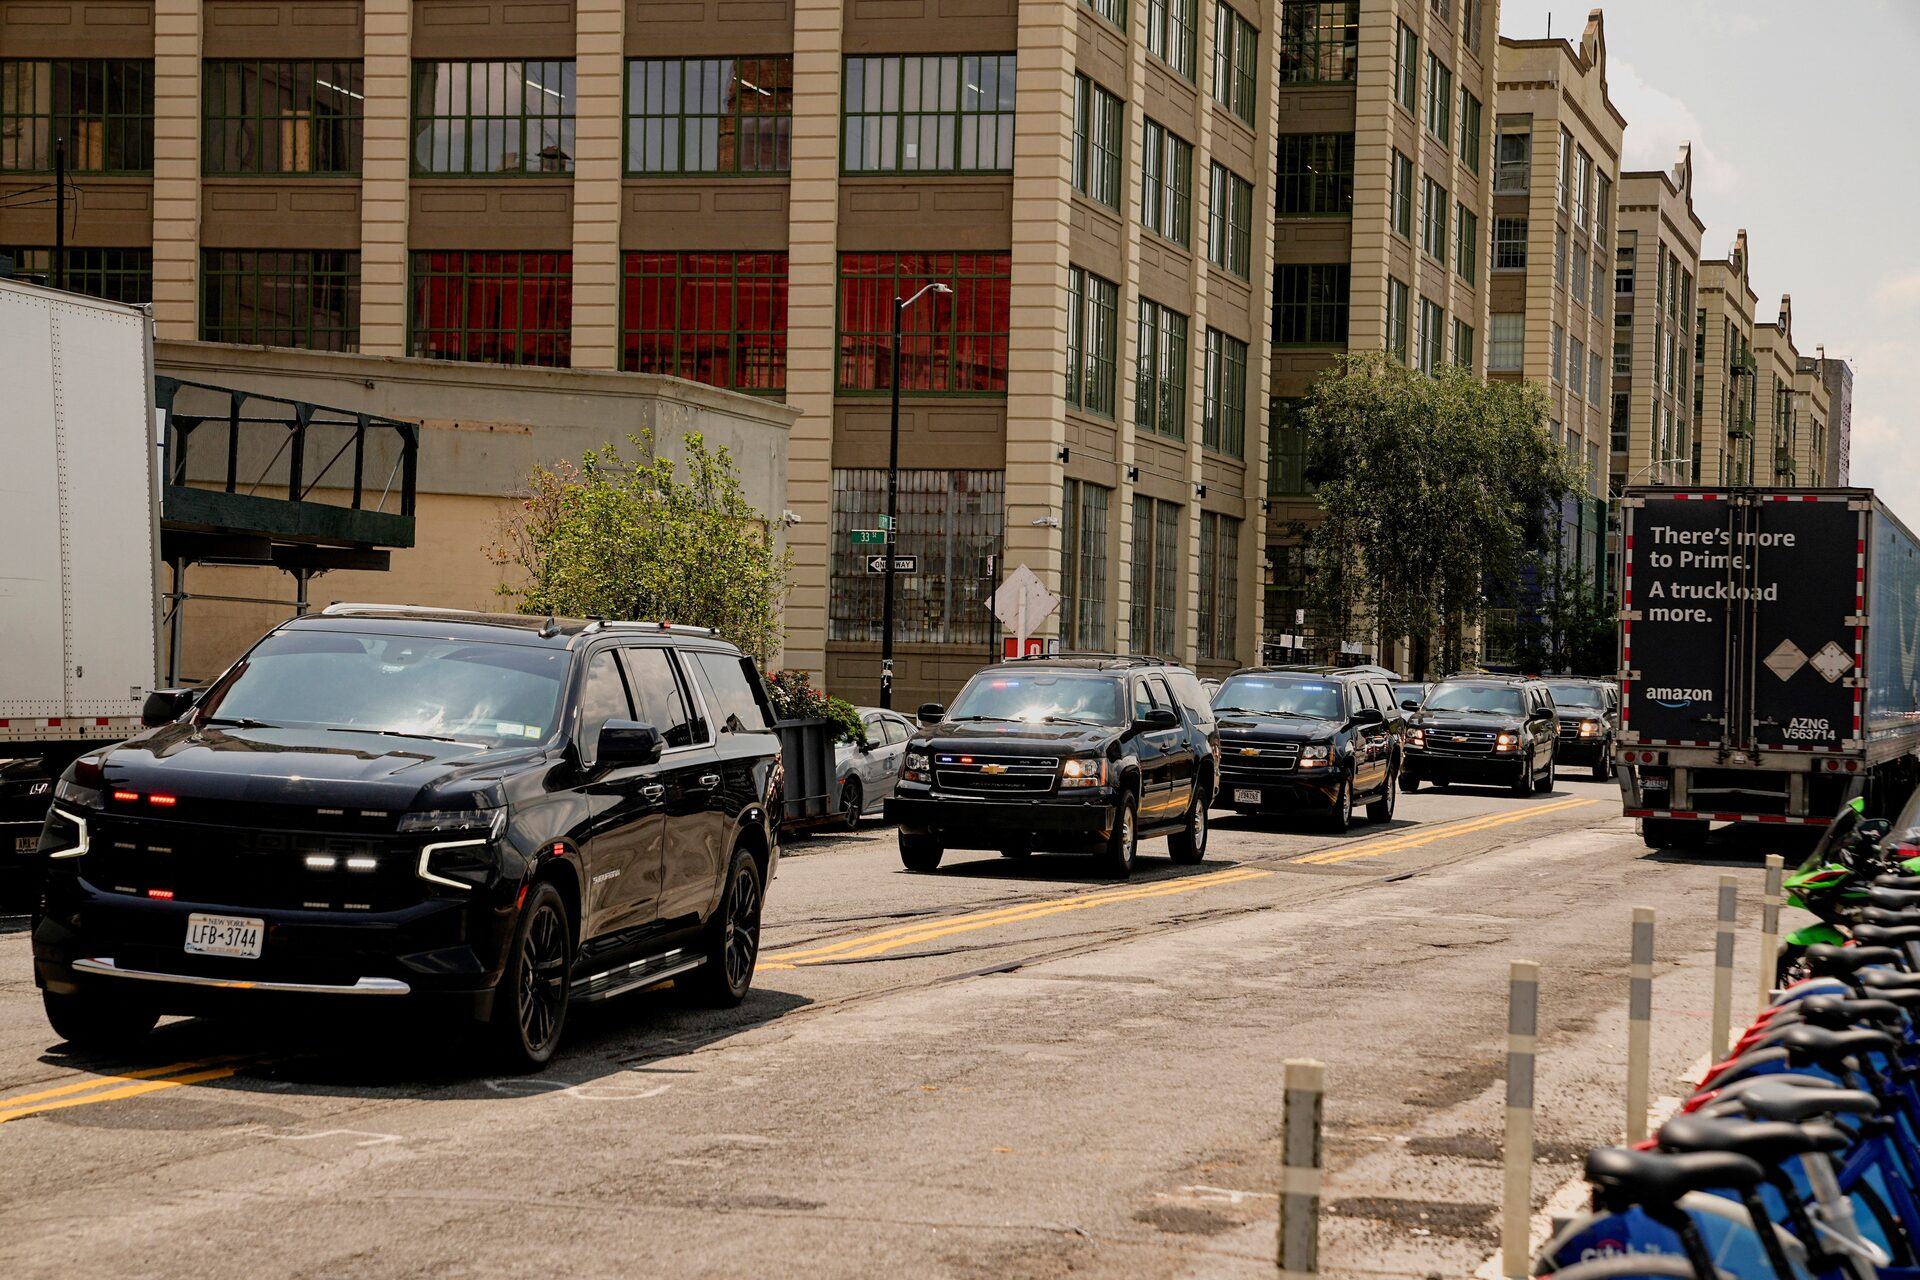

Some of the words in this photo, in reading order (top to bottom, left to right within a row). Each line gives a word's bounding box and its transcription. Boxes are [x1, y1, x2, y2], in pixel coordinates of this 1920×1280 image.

[861, 532, 870, 542] 33
[1737, 531, 1796, 547] more
[895, 560, 911, 569] WAY
[1649, 551, 1673, 568] to
[1679, 550, 1751, 570] Prime.
[1648, 580, 1665, 598] A
[1670, 580, 1778, 601] truckload
[1649, 607, 1713, 623] more.
[1646, 686, 1713, 702] amazon
[1789, 717, 1829, 730] AZNG
[1782, 728, 1836, 740] V563714
[227, 919, 246, 927] YORK
